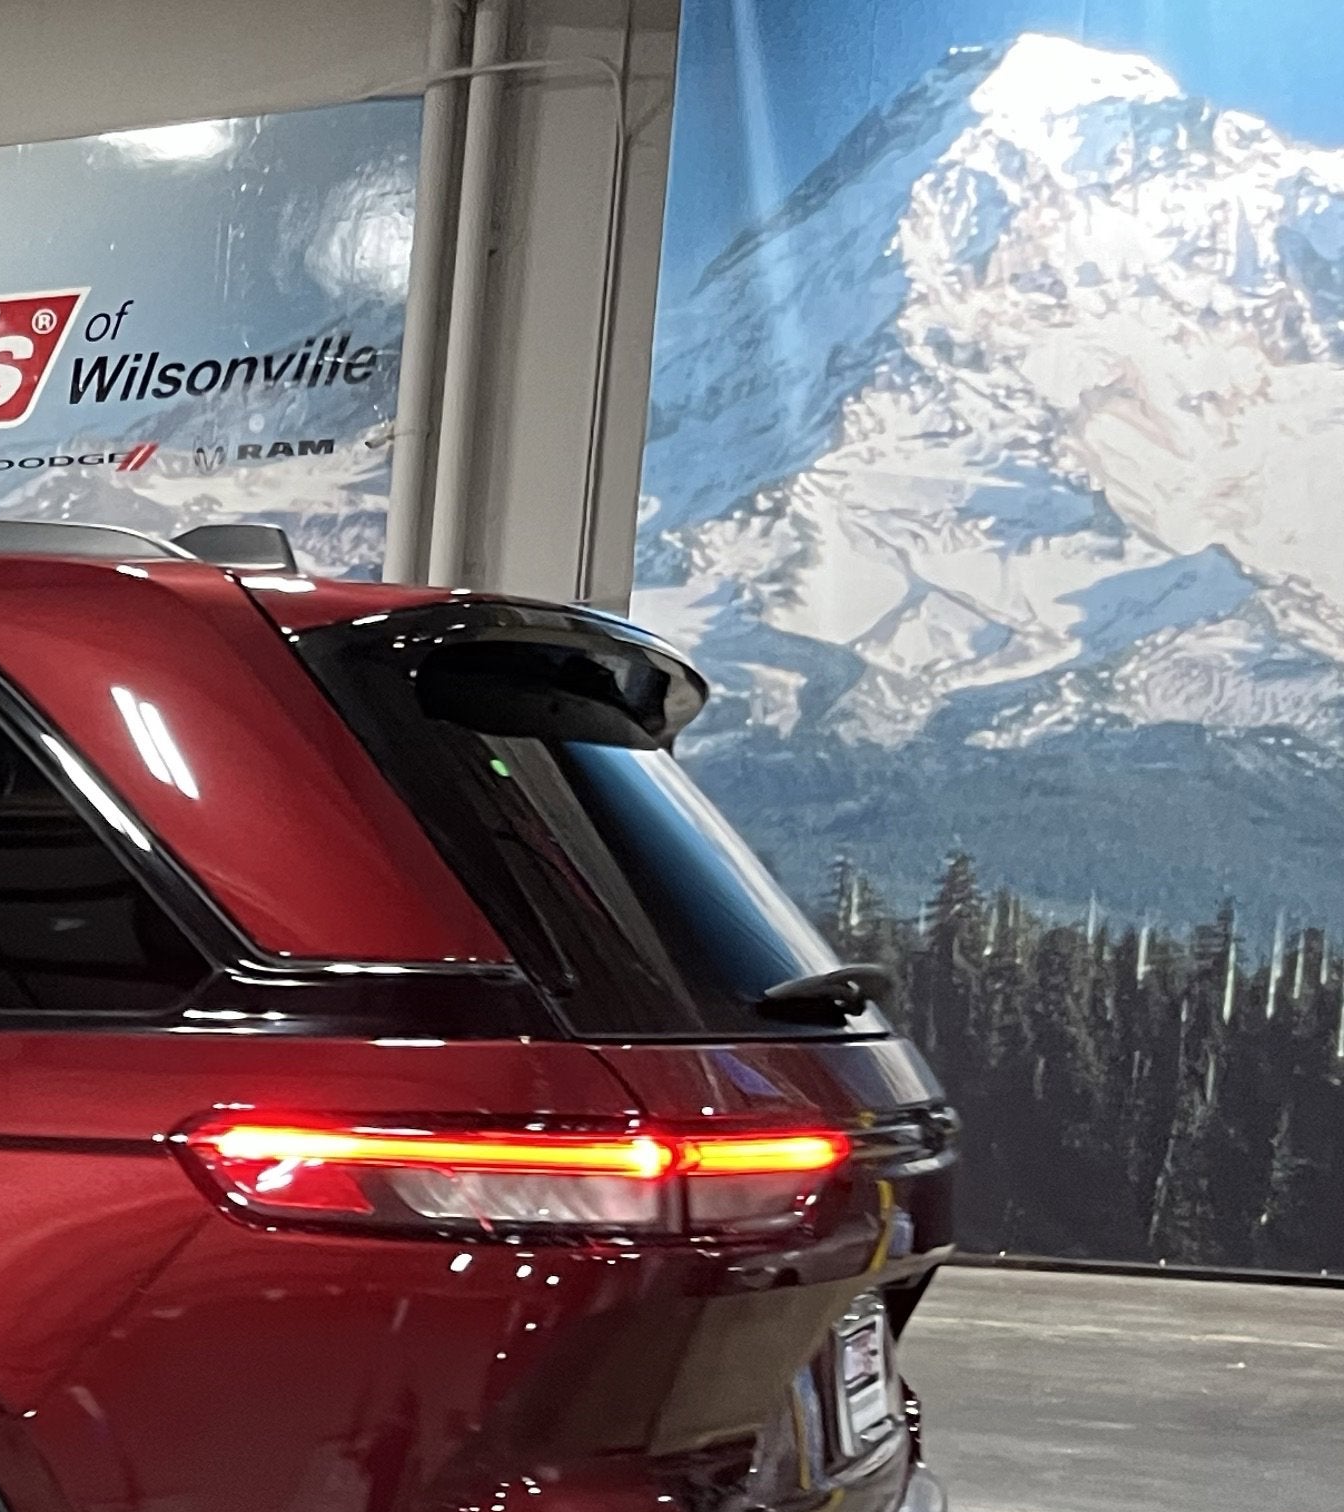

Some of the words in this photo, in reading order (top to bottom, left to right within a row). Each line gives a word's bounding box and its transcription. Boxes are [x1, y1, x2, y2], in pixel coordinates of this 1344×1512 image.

[85, 300, 134, 342] of
[69, 335, 378, 404] Wilsonville
[237, 439, 335, 460] RAM
